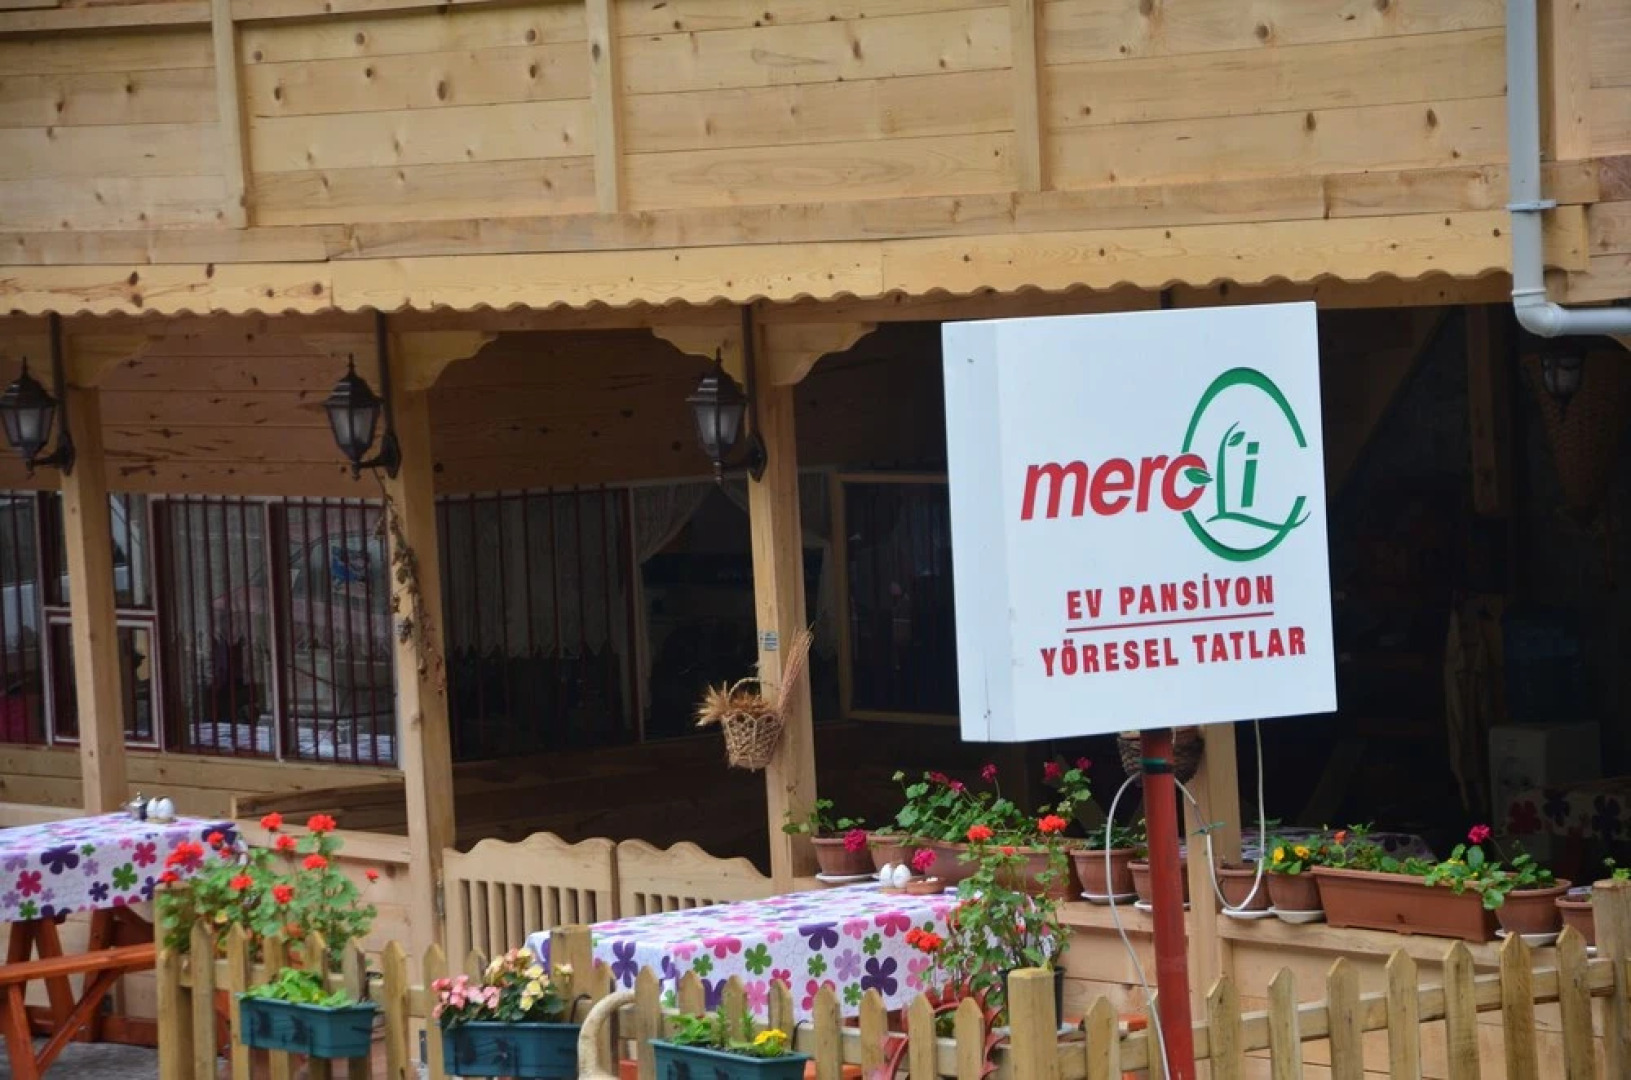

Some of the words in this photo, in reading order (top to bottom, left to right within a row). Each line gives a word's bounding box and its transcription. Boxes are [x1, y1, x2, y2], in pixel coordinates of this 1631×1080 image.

[1067, 590, 1102, 620] EV
[1119, 573, 1274, 615] PANSİYON
[1040, 638, 1179, 677] YÖRESEL
[1193, 627, 1306, 664] TATLAR
